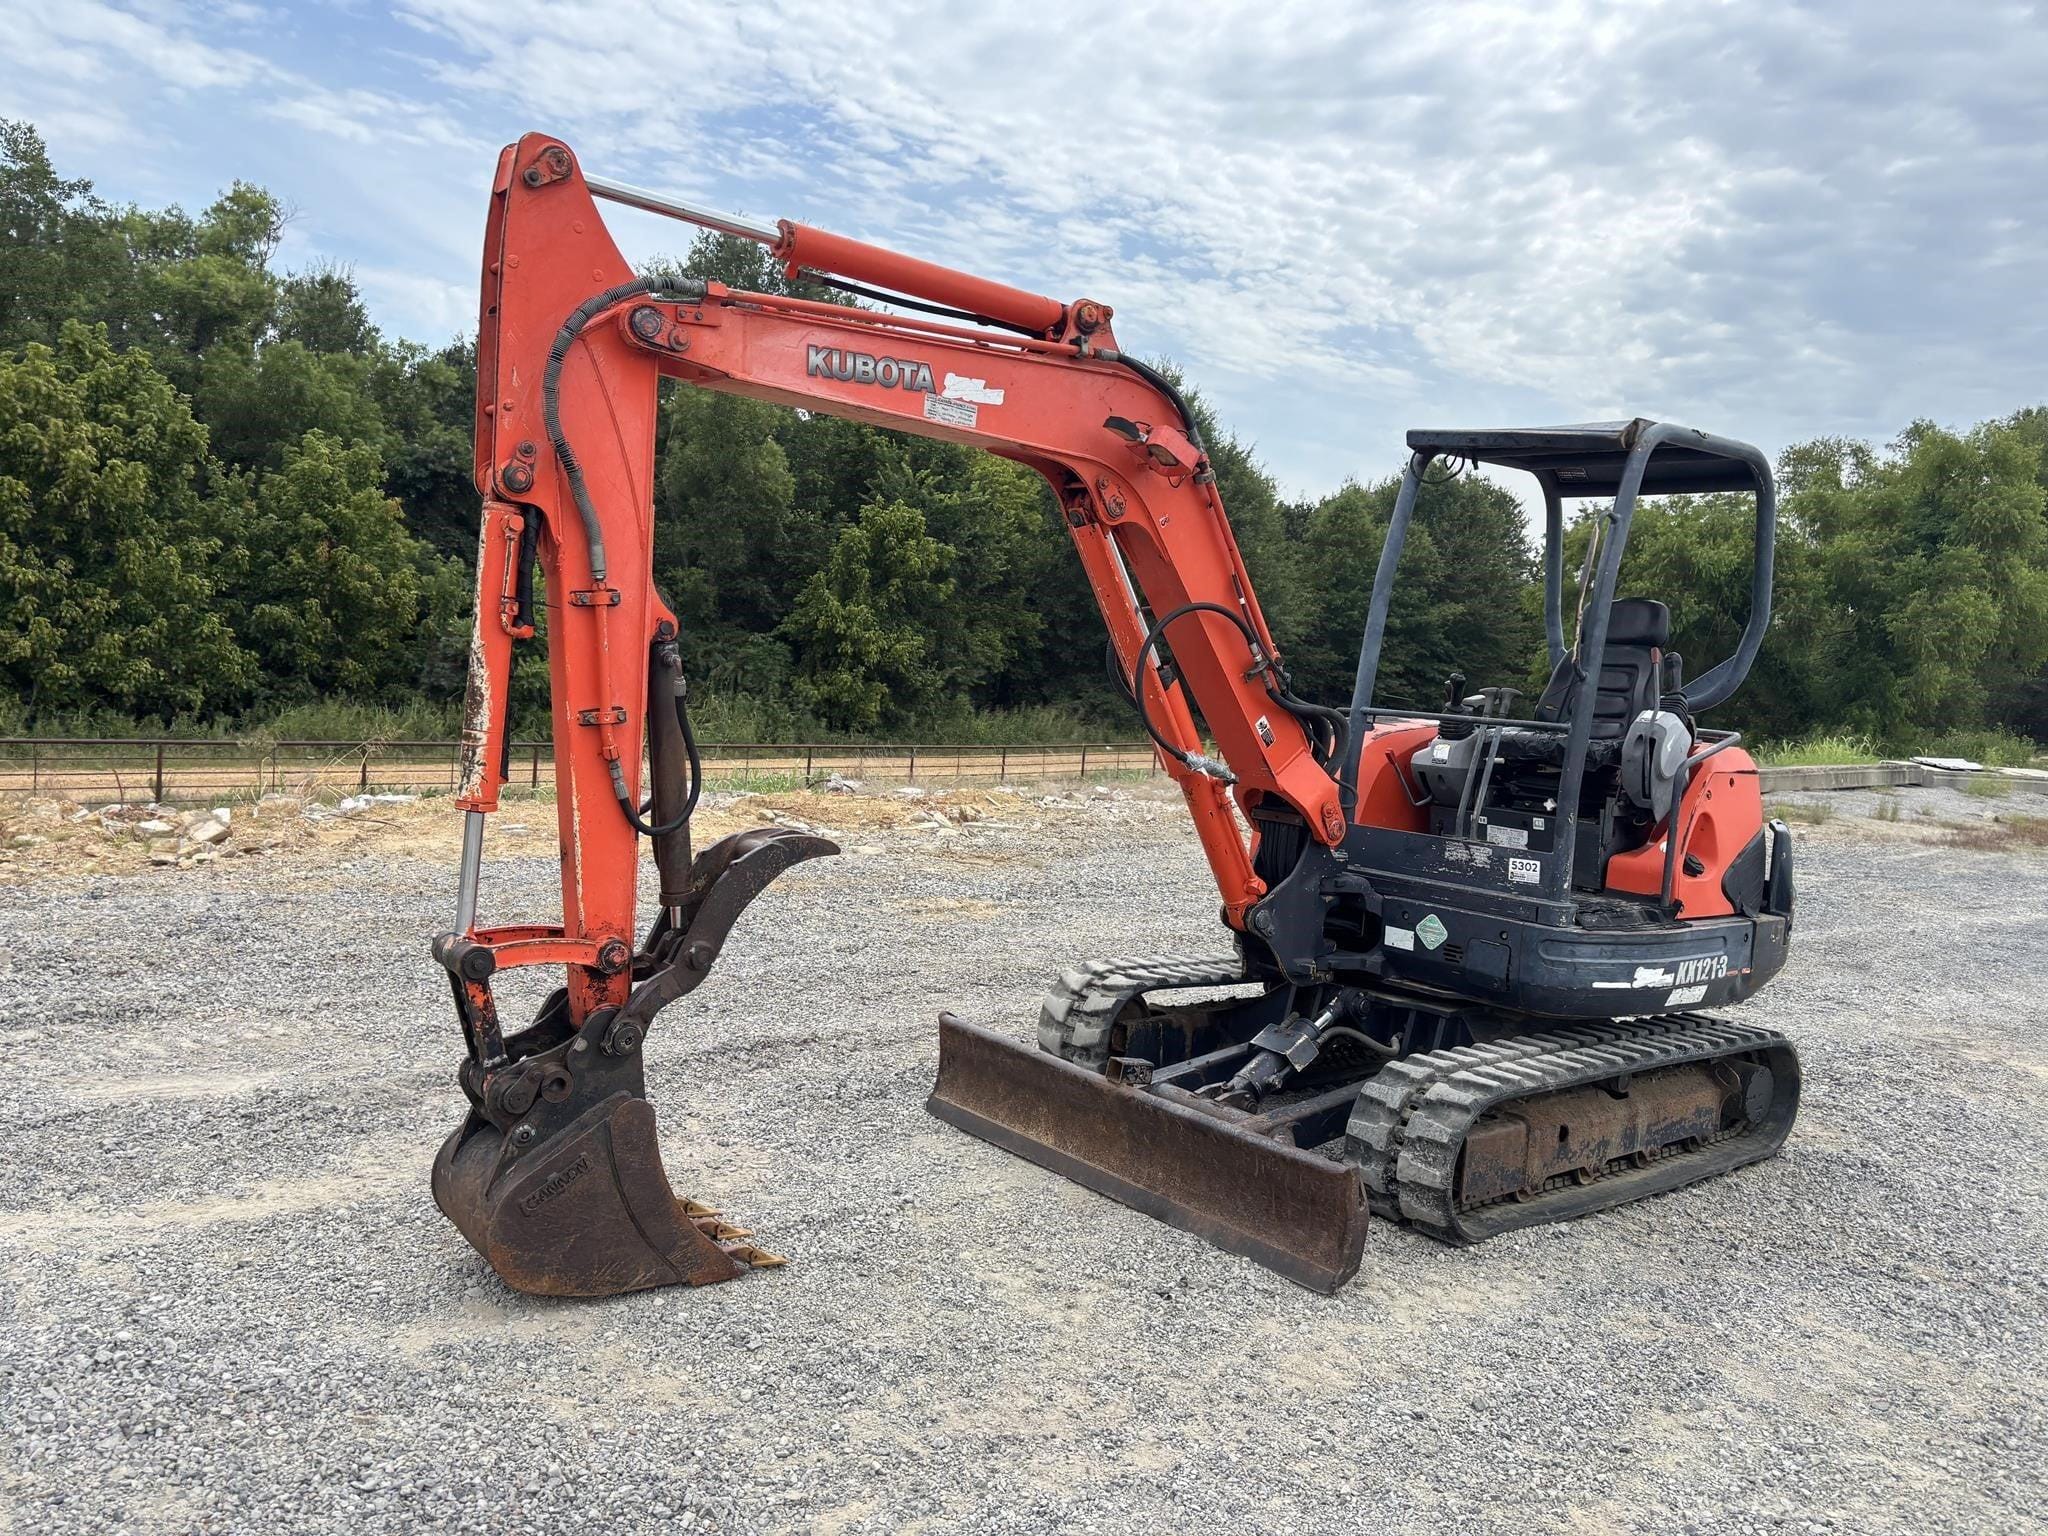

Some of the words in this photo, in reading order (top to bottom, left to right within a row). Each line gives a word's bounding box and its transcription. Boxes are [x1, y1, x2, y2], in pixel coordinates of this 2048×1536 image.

[807, 344, 937, 394] KUBOTA
[1511, 861, 1538, 873] 5302
[1675, 955, 1728, 986] KX121-3
